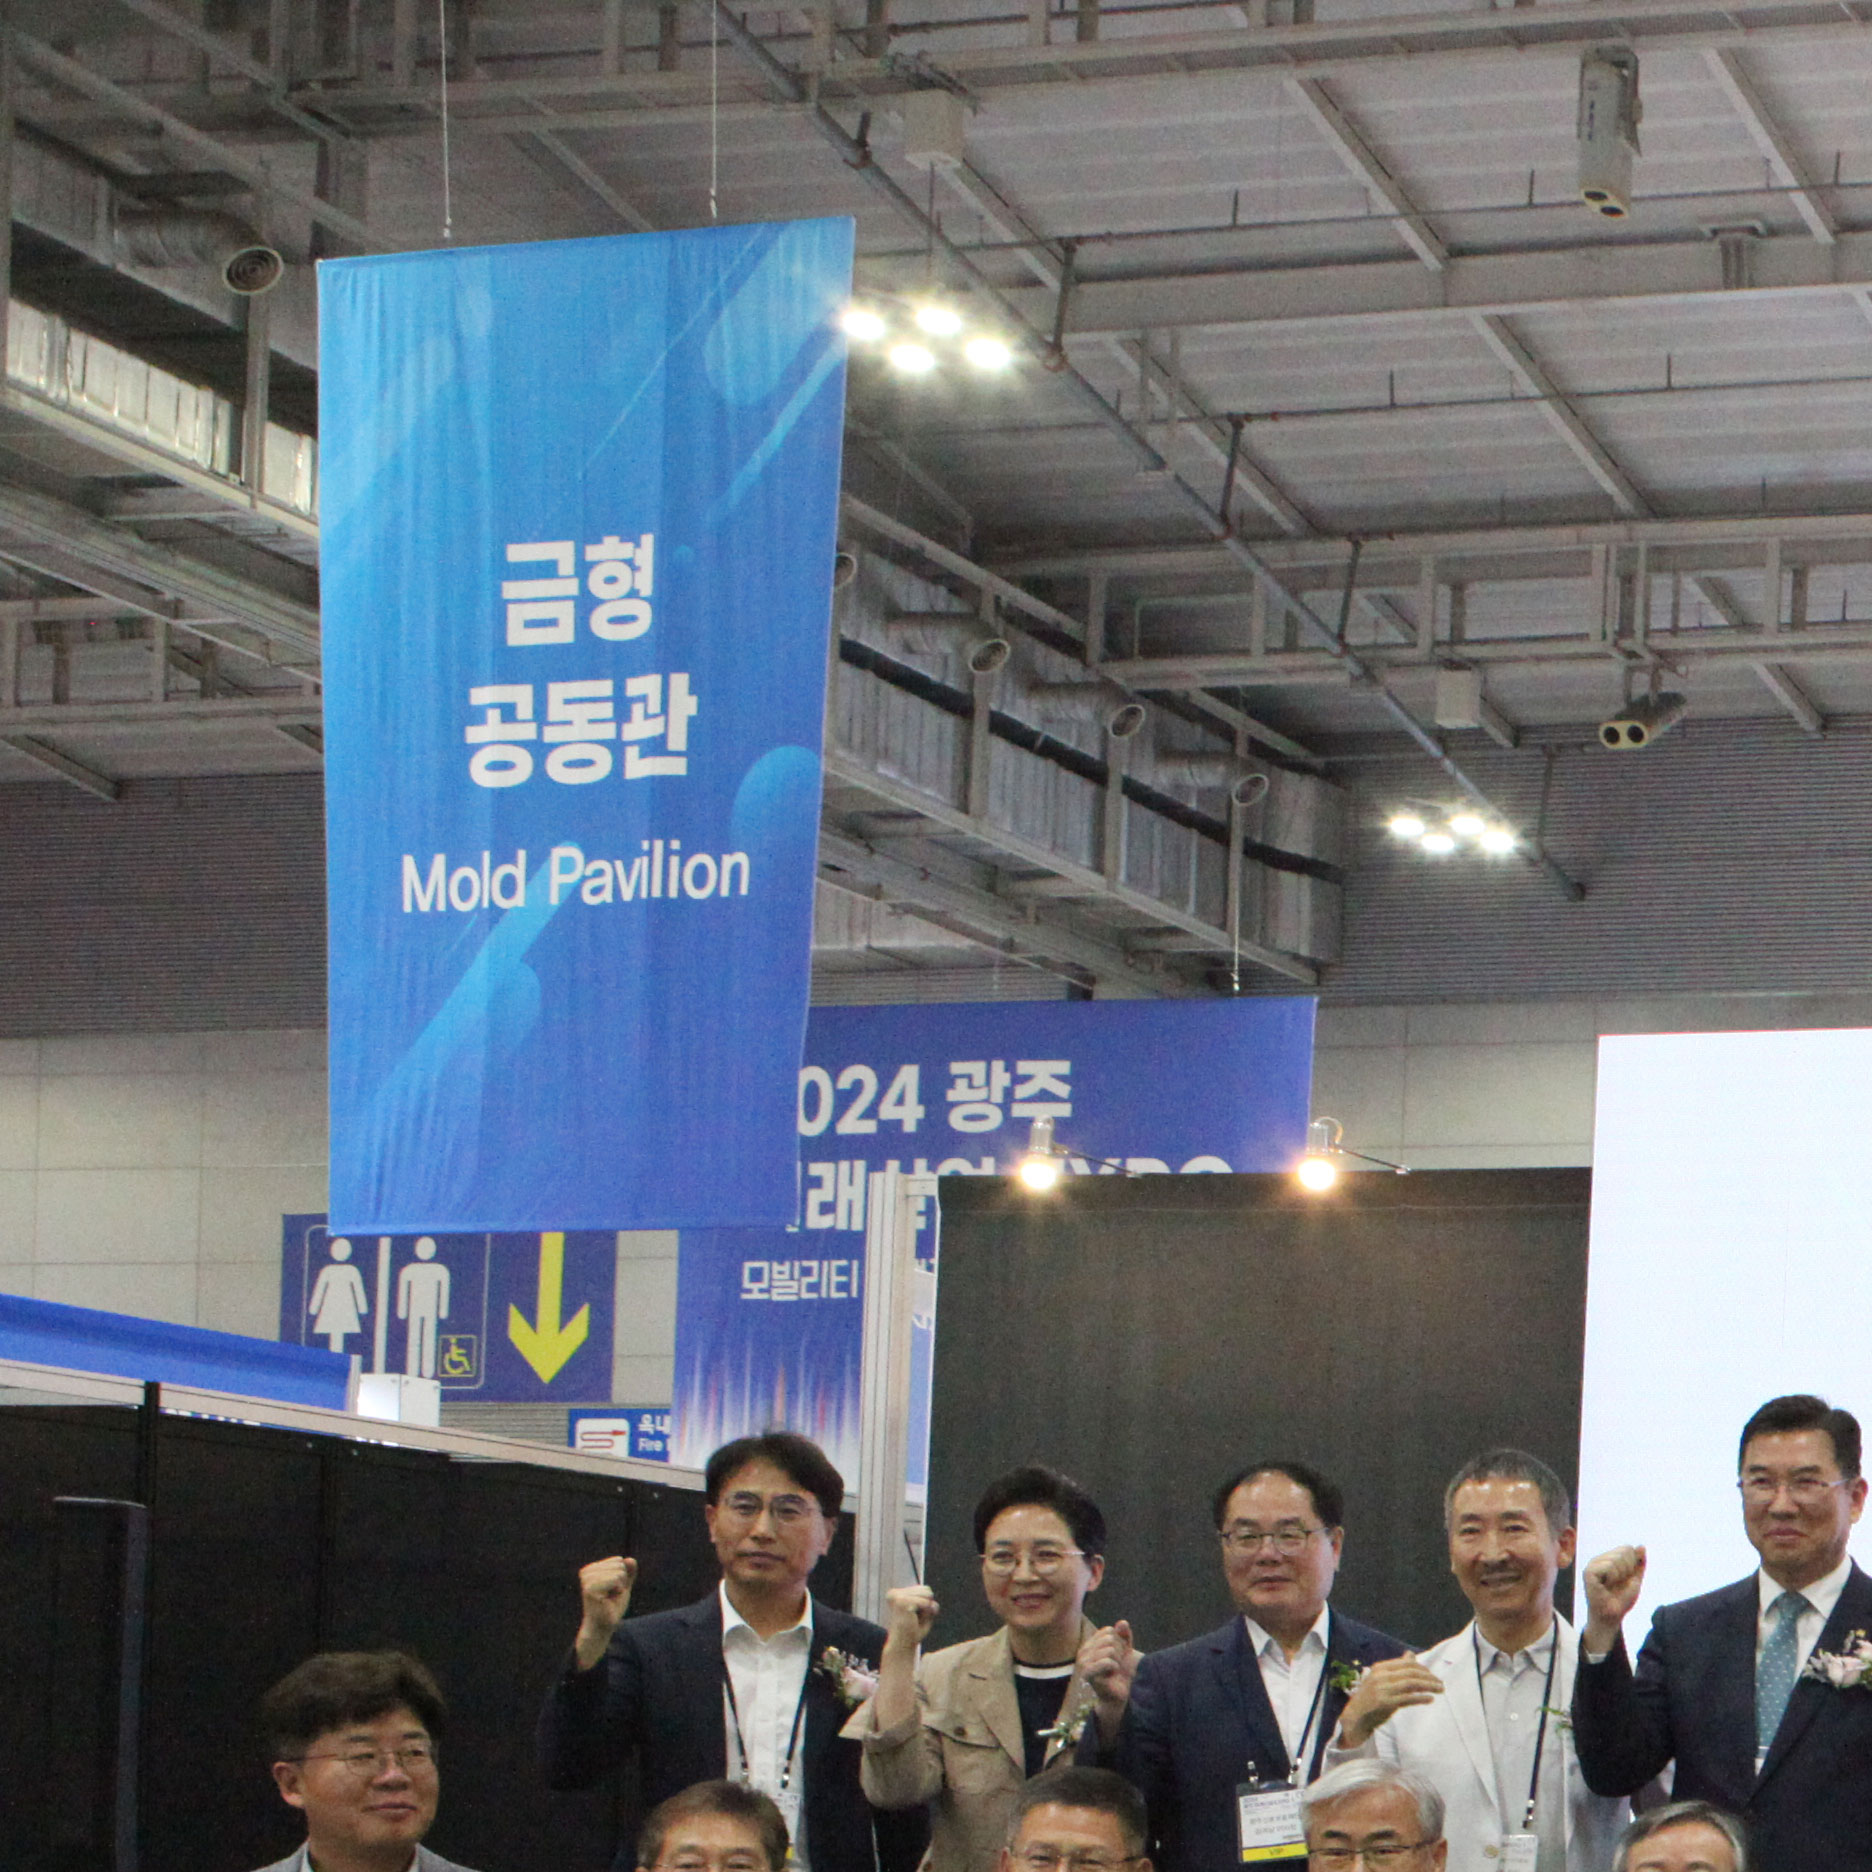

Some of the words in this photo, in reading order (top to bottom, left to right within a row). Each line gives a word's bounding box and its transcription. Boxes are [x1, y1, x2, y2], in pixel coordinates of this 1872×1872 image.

[502, 533, 654, 646] 금형
[465, 672, 698, 788] 공동관
[402, 848, 526, 913] Mold
[549, 838, 750, 905] Pavilion
[797, 1064, 924, 1137] 024
[946, 1060, 1072, 1133] 광주
[740, 1258, 858, 1301] 모빌리티
[638, 1437, 664, 1452] Fire
